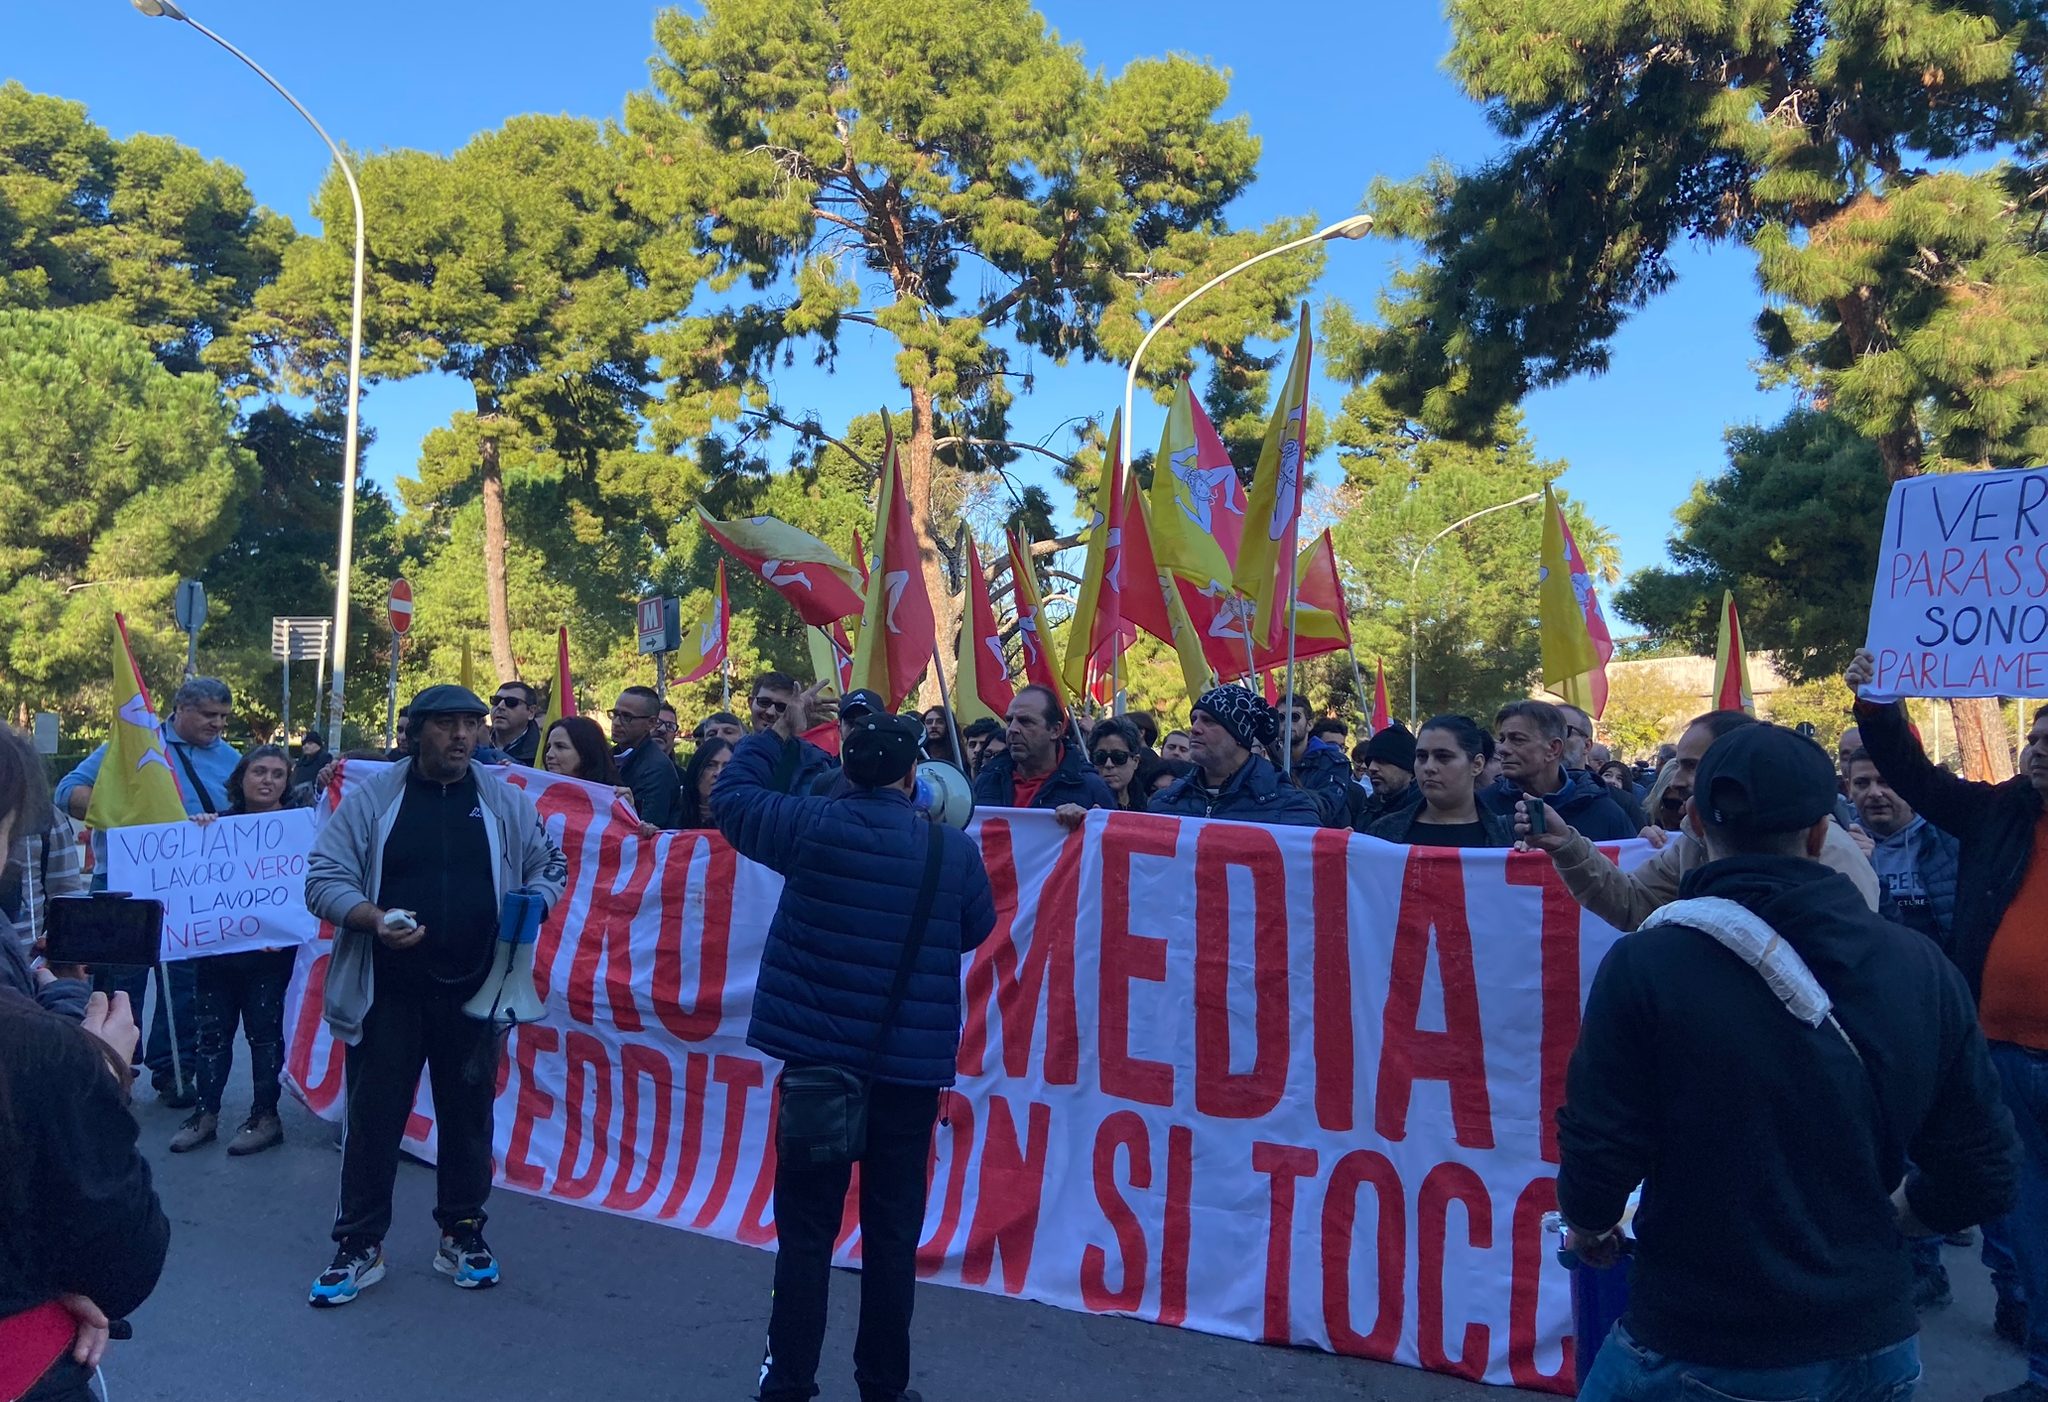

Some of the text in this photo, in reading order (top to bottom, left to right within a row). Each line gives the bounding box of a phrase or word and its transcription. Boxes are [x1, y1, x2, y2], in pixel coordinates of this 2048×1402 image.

[1896, 487, 1907, 549] I
[643, 602, 658, 630] M
[1915, 604, 2048, 647] SONO
[120, 818, 284, 867] VOGLIAMO
[151, 854, 304, 892] LAVORO VERO
[190, 886, 289, 915] LAVORO
[166, 916, 260, 951] NERO
[957, 811, 1621, 1164] MEDIAT
[1080, 1110, 1193, 1326] SI
[1251, 1141, 1577, 1396] TOCC
